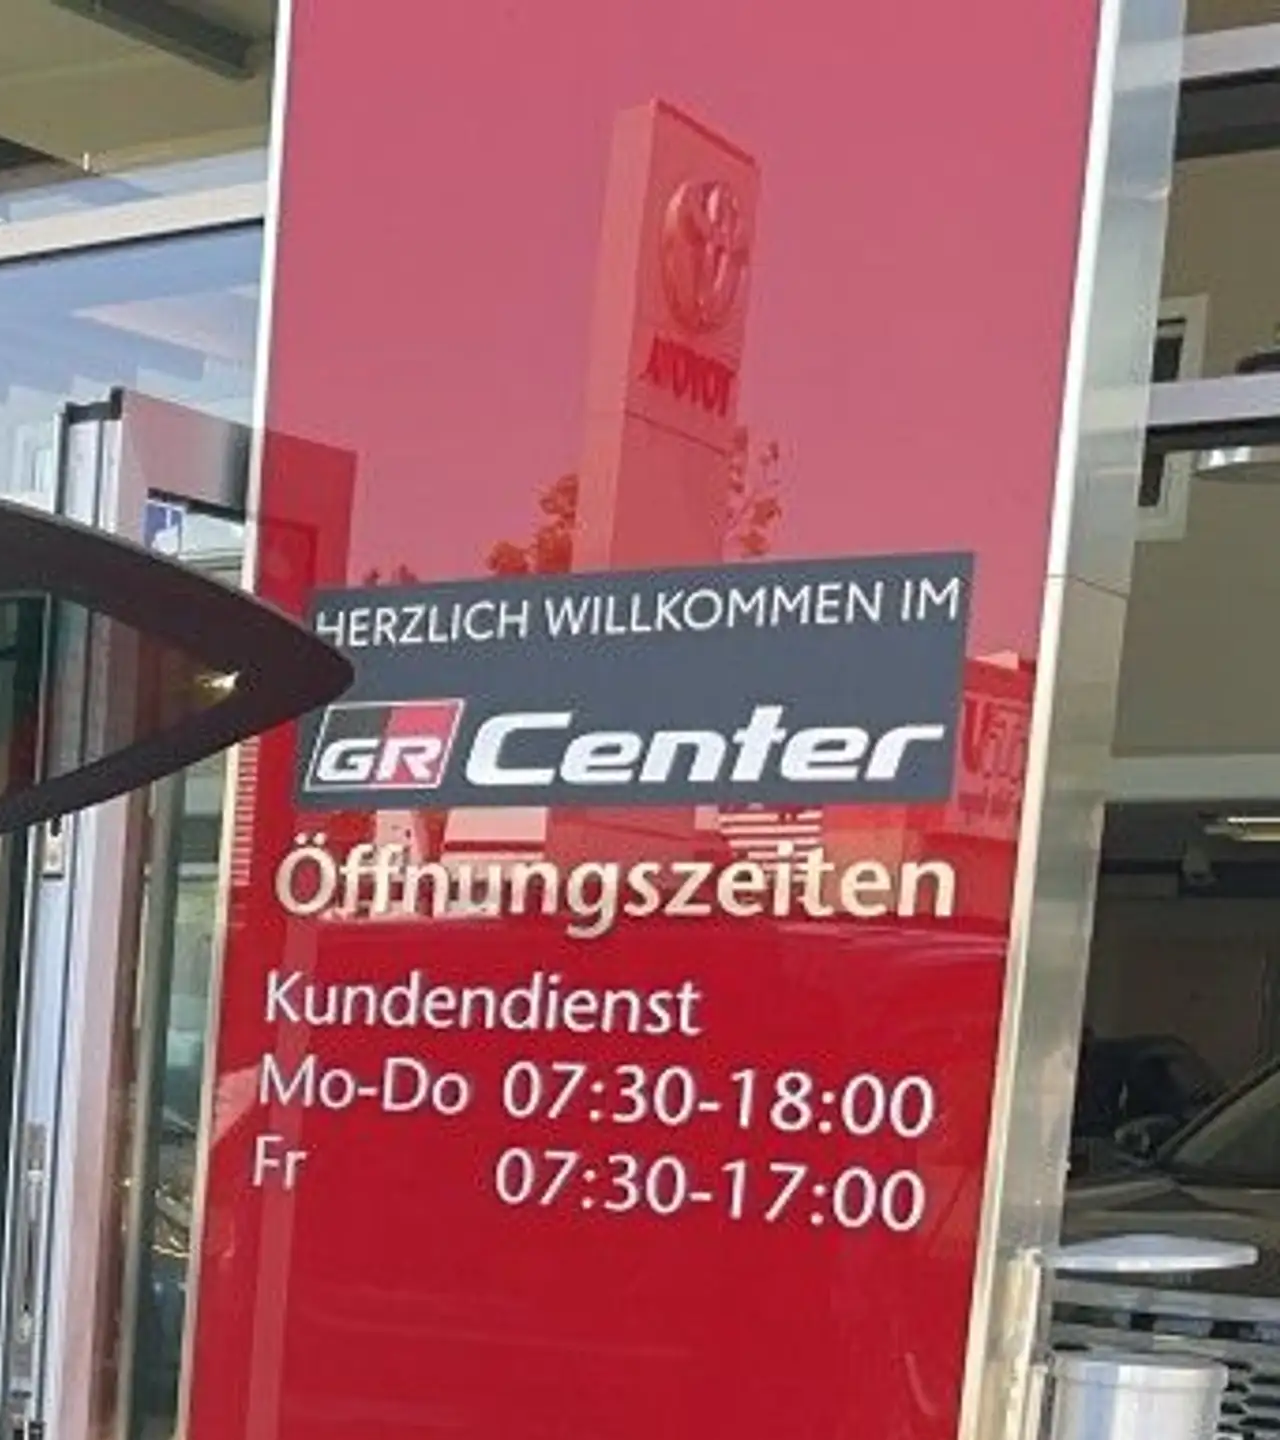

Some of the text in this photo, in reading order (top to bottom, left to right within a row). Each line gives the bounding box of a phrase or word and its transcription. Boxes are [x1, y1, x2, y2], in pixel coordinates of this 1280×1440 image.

[315, 576, 962, 648] HERZLICH WILLKOMMEN IM
[316, 737, 439, 783] GR
[465, 704, 945, 786] Center
[274, 833, 955, 939] Öffnungszeiten
[264, 971, 702, 1037] Kundendienst
[258, 1053, 935, 1139] Mo-Do 07:30-18:00
[251, 1135, 927, 1232] Fr 07:30-17:00
